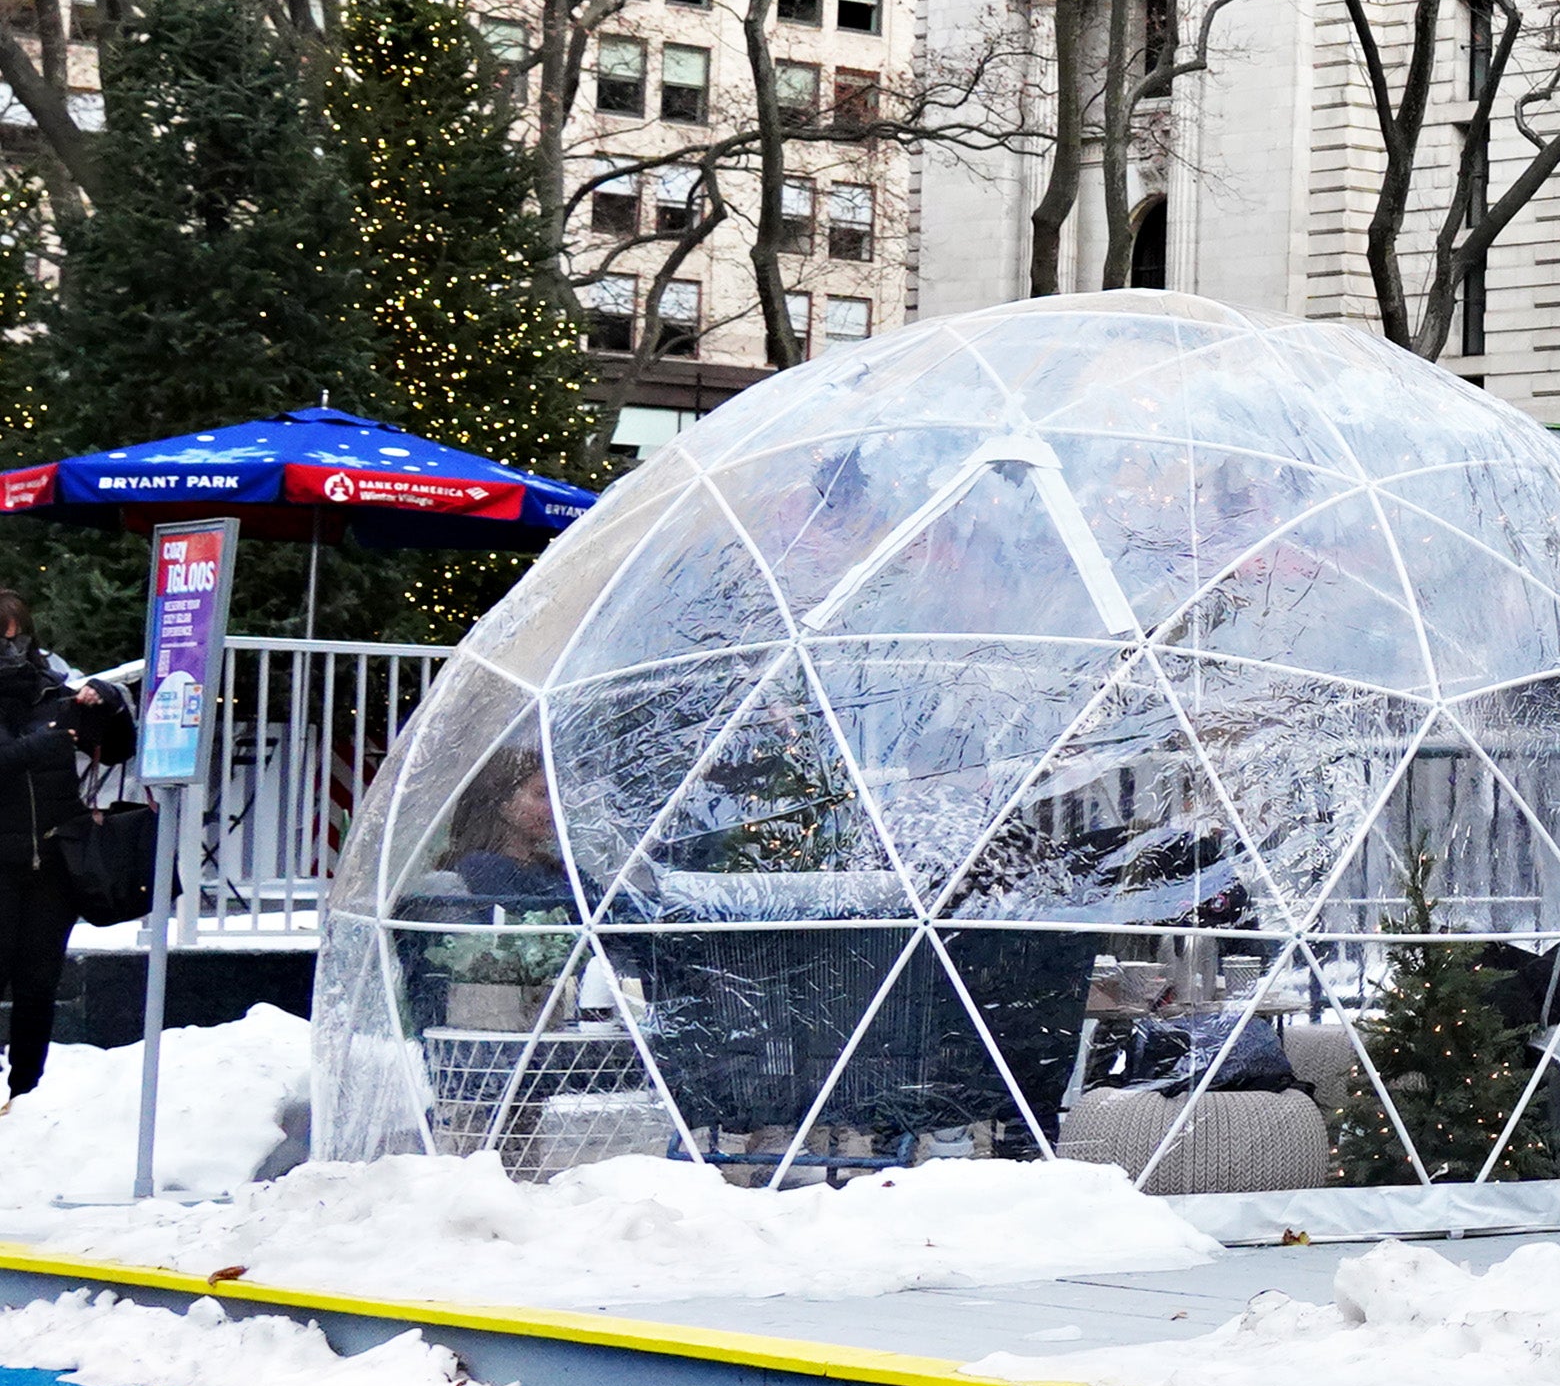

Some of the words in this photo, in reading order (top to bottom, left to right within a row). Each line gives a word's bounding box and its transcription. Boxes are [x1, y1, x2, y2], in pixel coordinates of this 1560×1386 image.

[98, 475, 180, 490] BRYANT
[186, 475, 240, 489] PARK
[358, 479, 393, 490] BANK
[393, 481, 409, 491] OF
[411, 483, 464, 498] AMERICA
[359, 490, 397, 501] Winter
[398, 492, 434, 507] Village
[166, 560, 215, 594] IGLOOS
